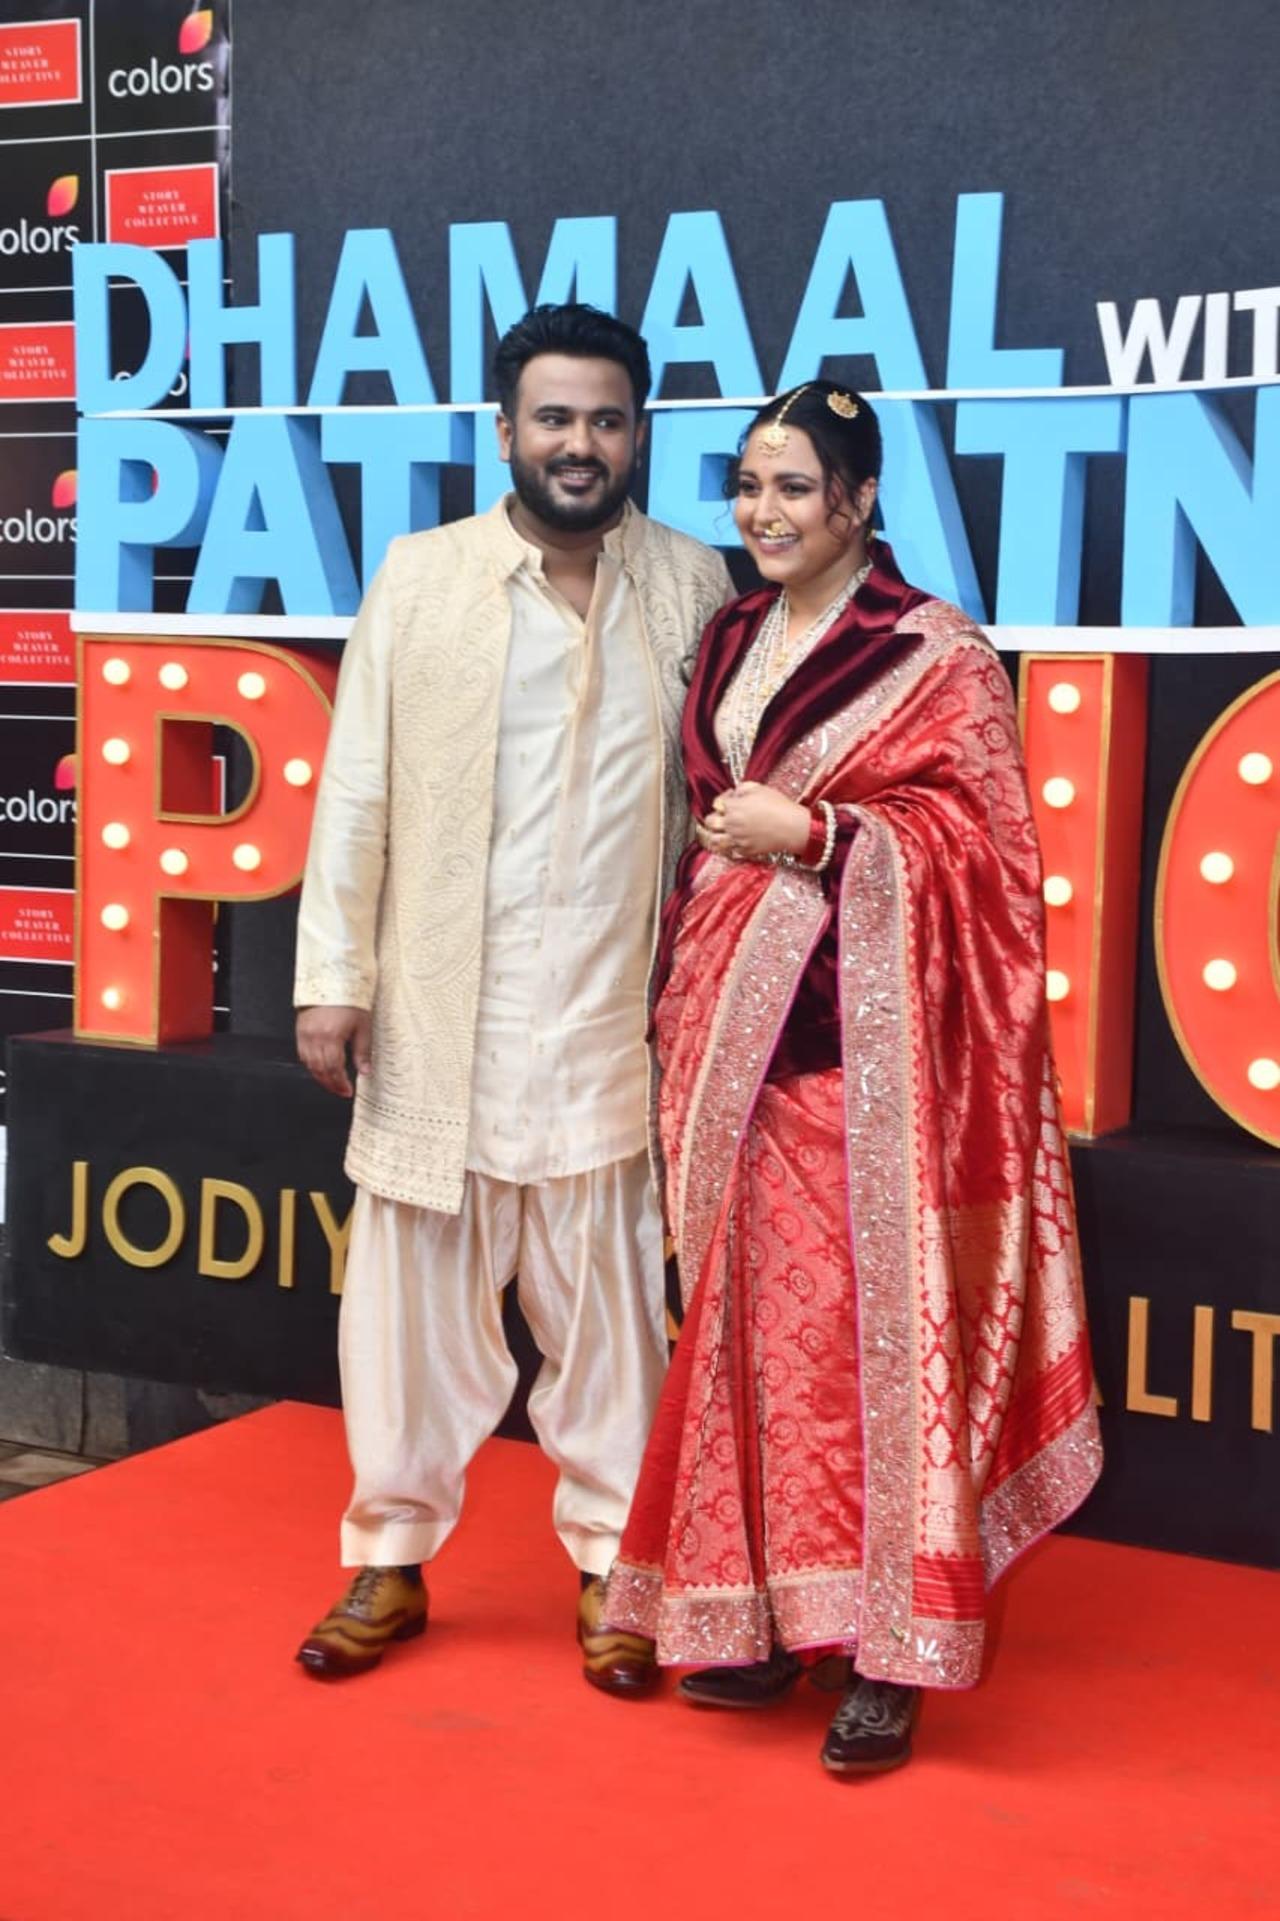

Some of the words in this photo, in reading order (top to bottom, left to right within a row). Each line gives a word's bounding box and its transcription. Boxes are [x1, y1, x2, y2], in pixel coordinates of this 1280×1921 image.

[108, 56, 214, 98] colors
[72, 191, 1064, 413] DHAMAAL
[0, 508, 78, 543] olor
[0, 789, 77, 824] olor
